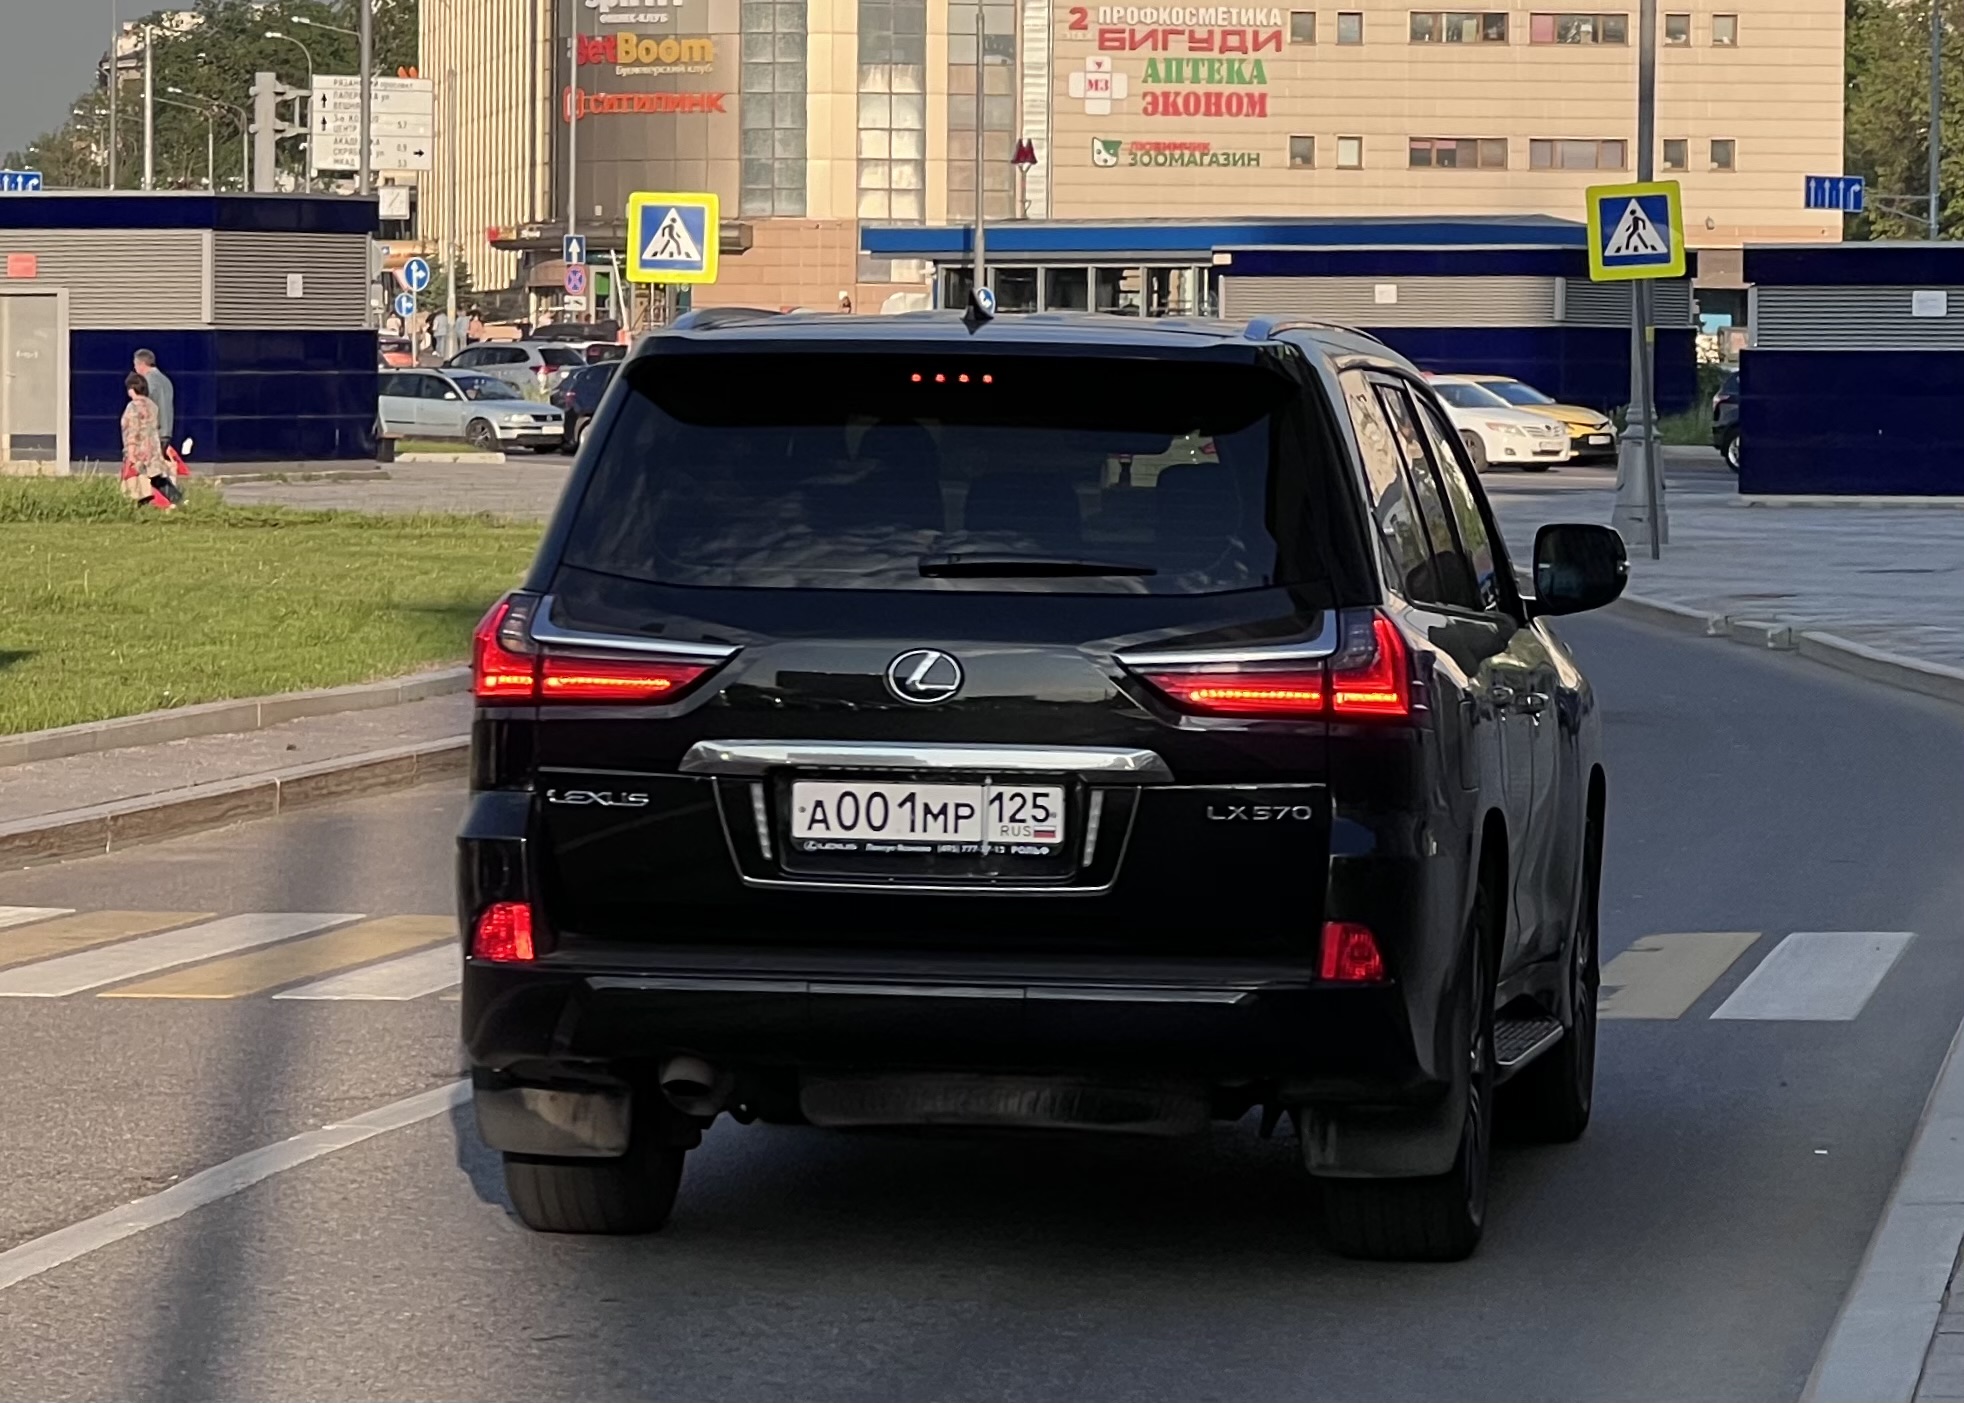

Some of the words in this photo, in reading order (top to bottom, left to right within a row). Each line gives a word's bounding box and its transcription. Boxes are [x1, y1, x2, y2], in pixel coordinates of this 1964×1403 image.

[1068, 6, 1089, 31] 2
[1098, 6, 1283, 26] ПРОФКОСМЕТИКА
[1098, 28, 1283, 54] БИГУДИ
[1141, 57, 1268, 85] АПТЕКА
[1141, 91, 1268, 118] ЭКОНОМ
[1128, 152, 1260, 167] ЗООМАГАЗИН
[546, 789, 650, 807] LEXUS
[988, 791, 1051, 824] 125
[1207, 806, 1248, 820] LX
[1253, 806, 1312, 820] 570
[1001, 825, 1032, 837] RUS
